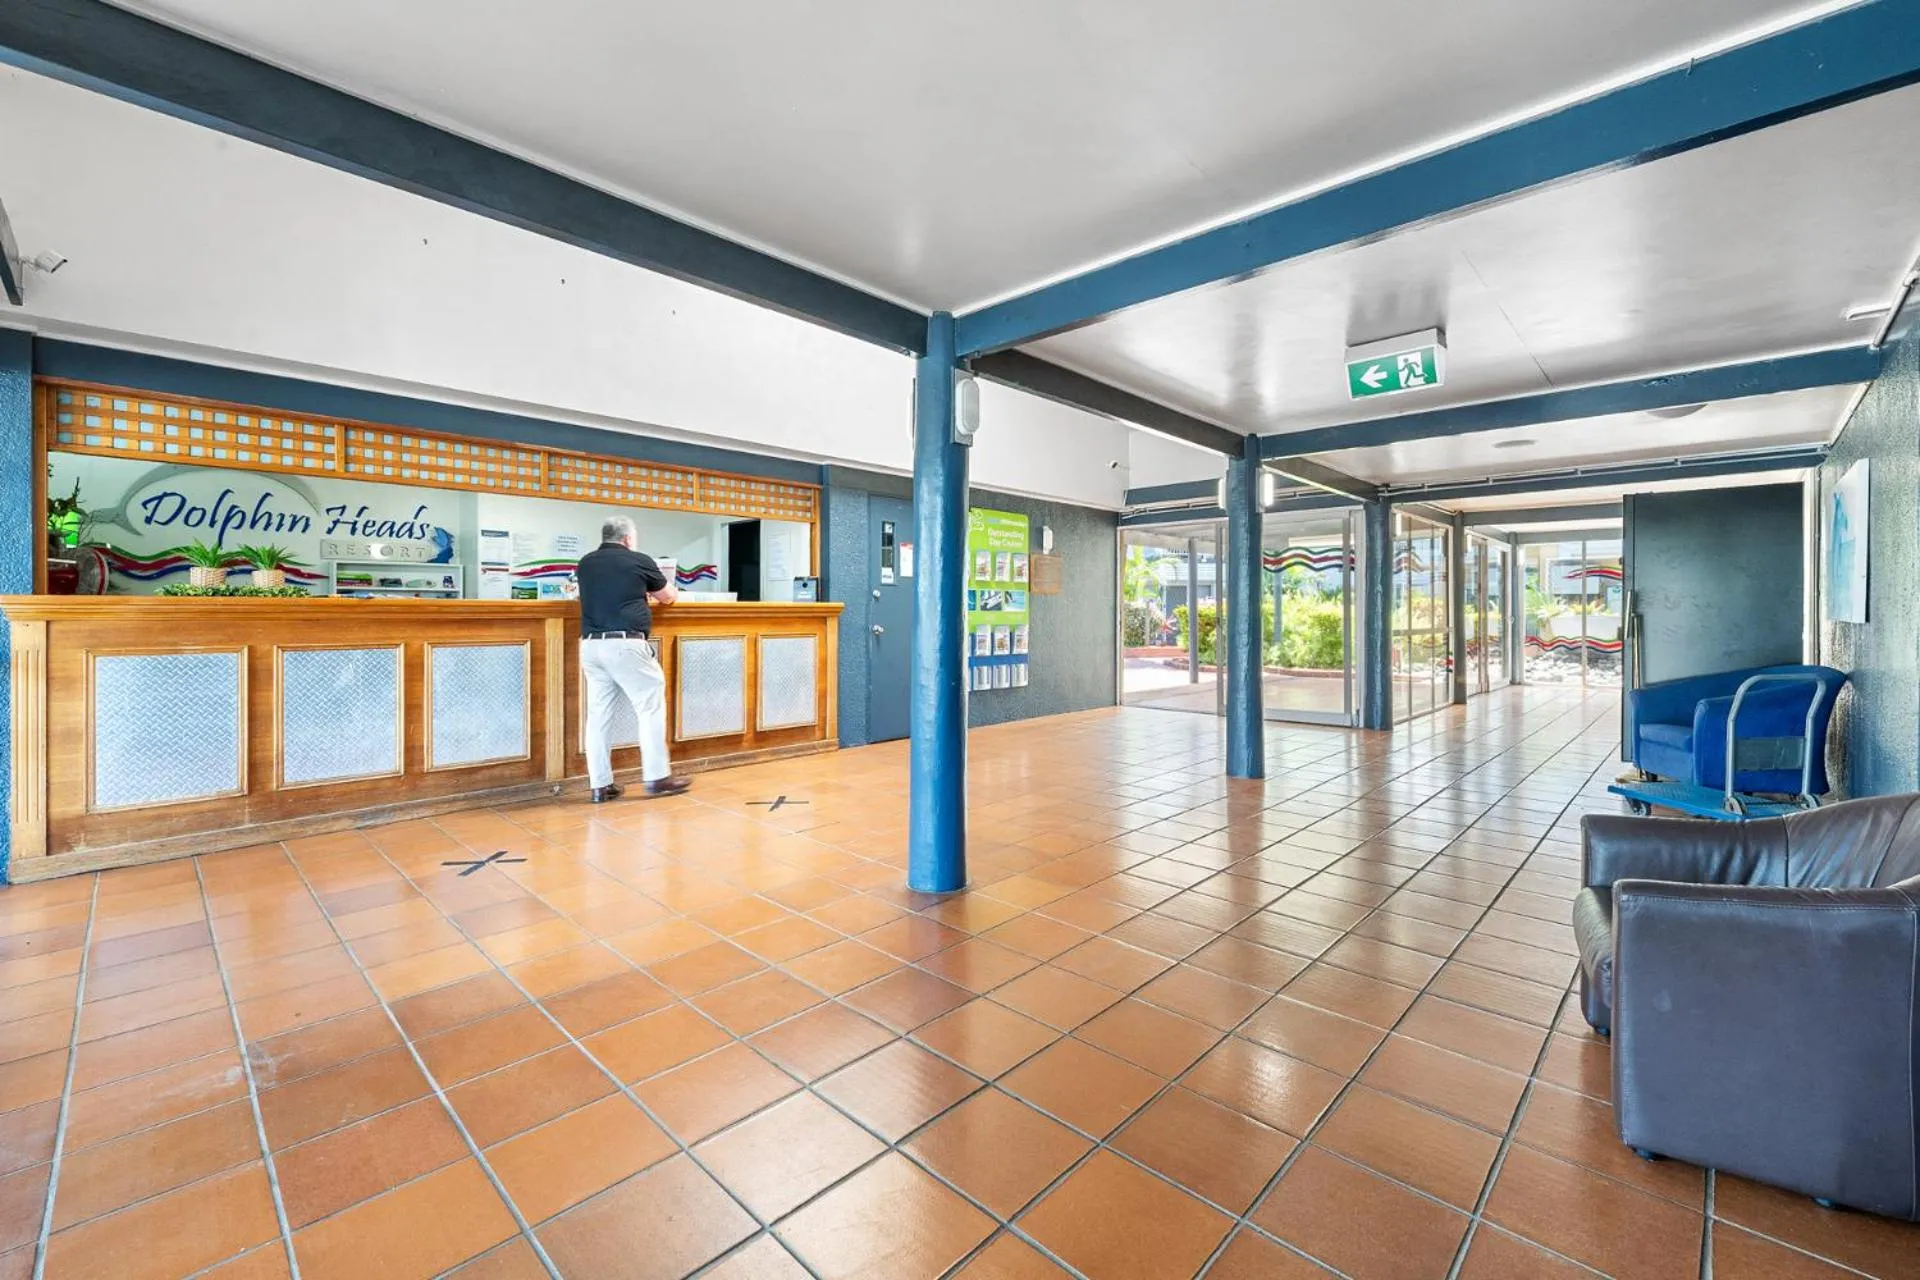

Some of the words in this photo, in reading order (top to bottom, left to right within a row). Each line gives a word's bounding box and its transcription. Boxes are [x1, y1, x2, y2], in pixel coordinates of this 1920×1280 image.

[141, 488, 312, 550] Dolphin
[325, 504, 430, 540] Heads
[328, 542, 426, 558] RESORT
